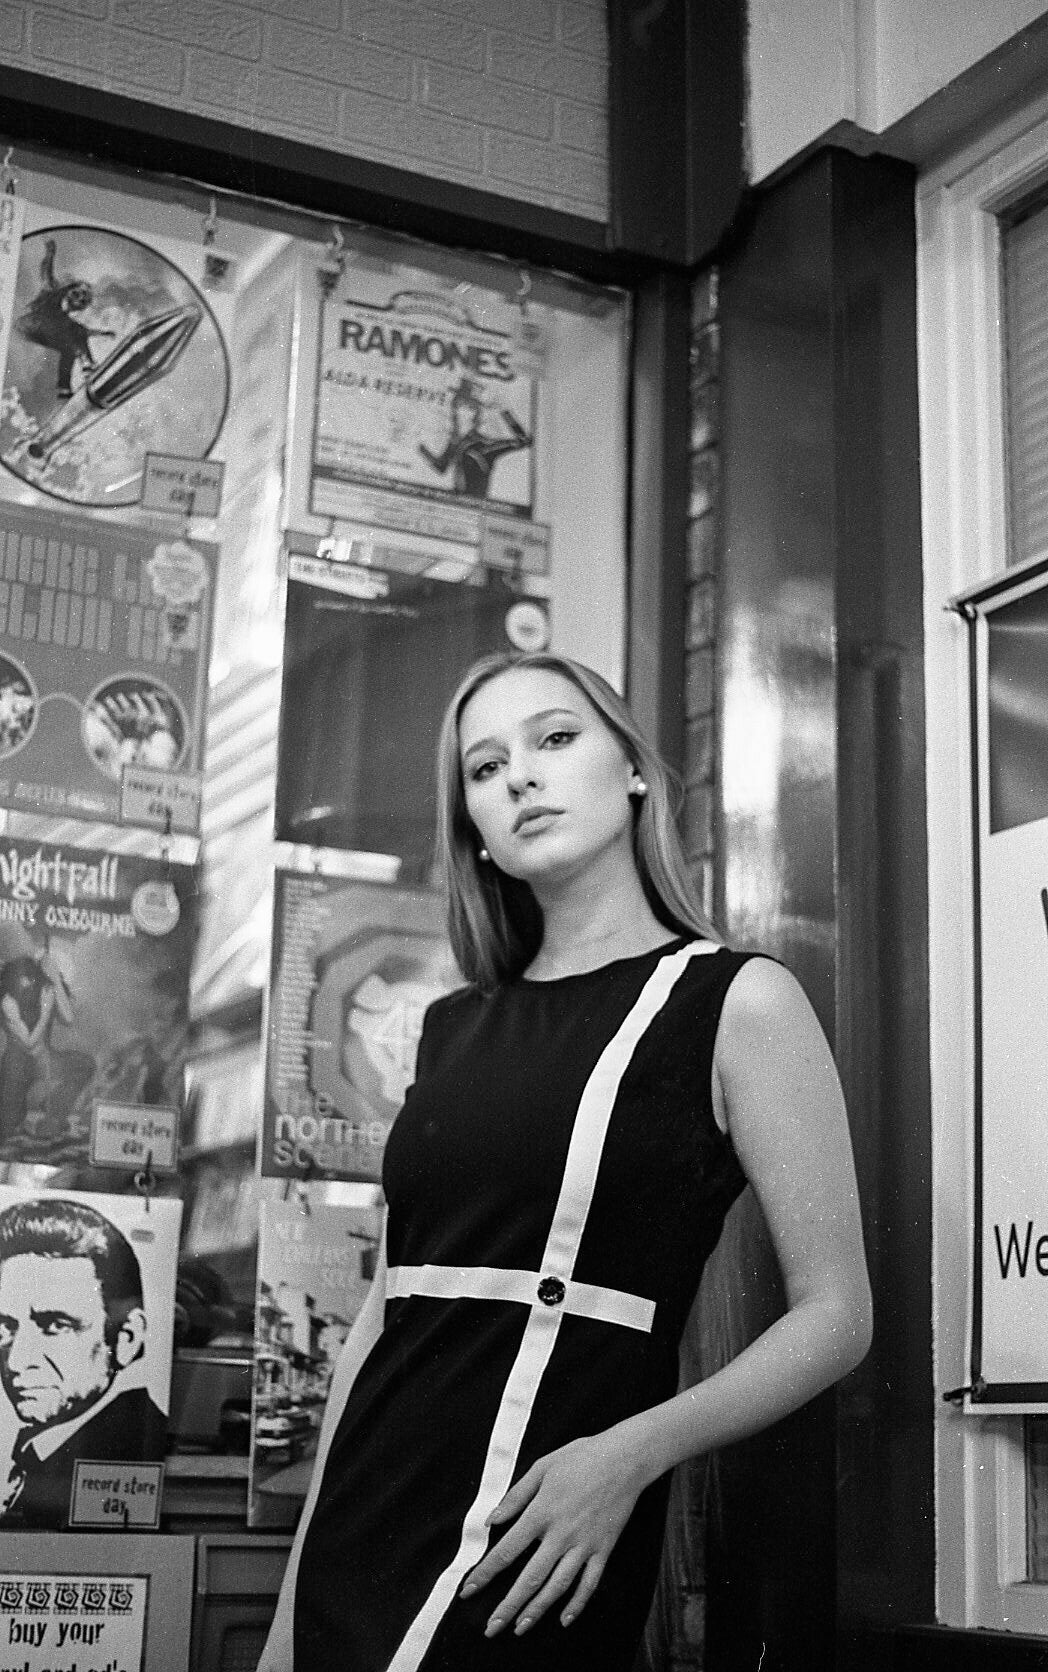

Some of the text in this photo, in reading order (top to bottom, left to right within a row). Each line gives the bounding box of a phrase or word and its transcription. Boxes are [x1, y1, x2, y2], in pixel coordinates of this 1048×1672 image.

[339, 318, 515, 383] RAMONES
[81, 1476, 156, 1495] record store
[103, 1497, 126, 1516] day
[9, 1618, 105, 1648] buy your
